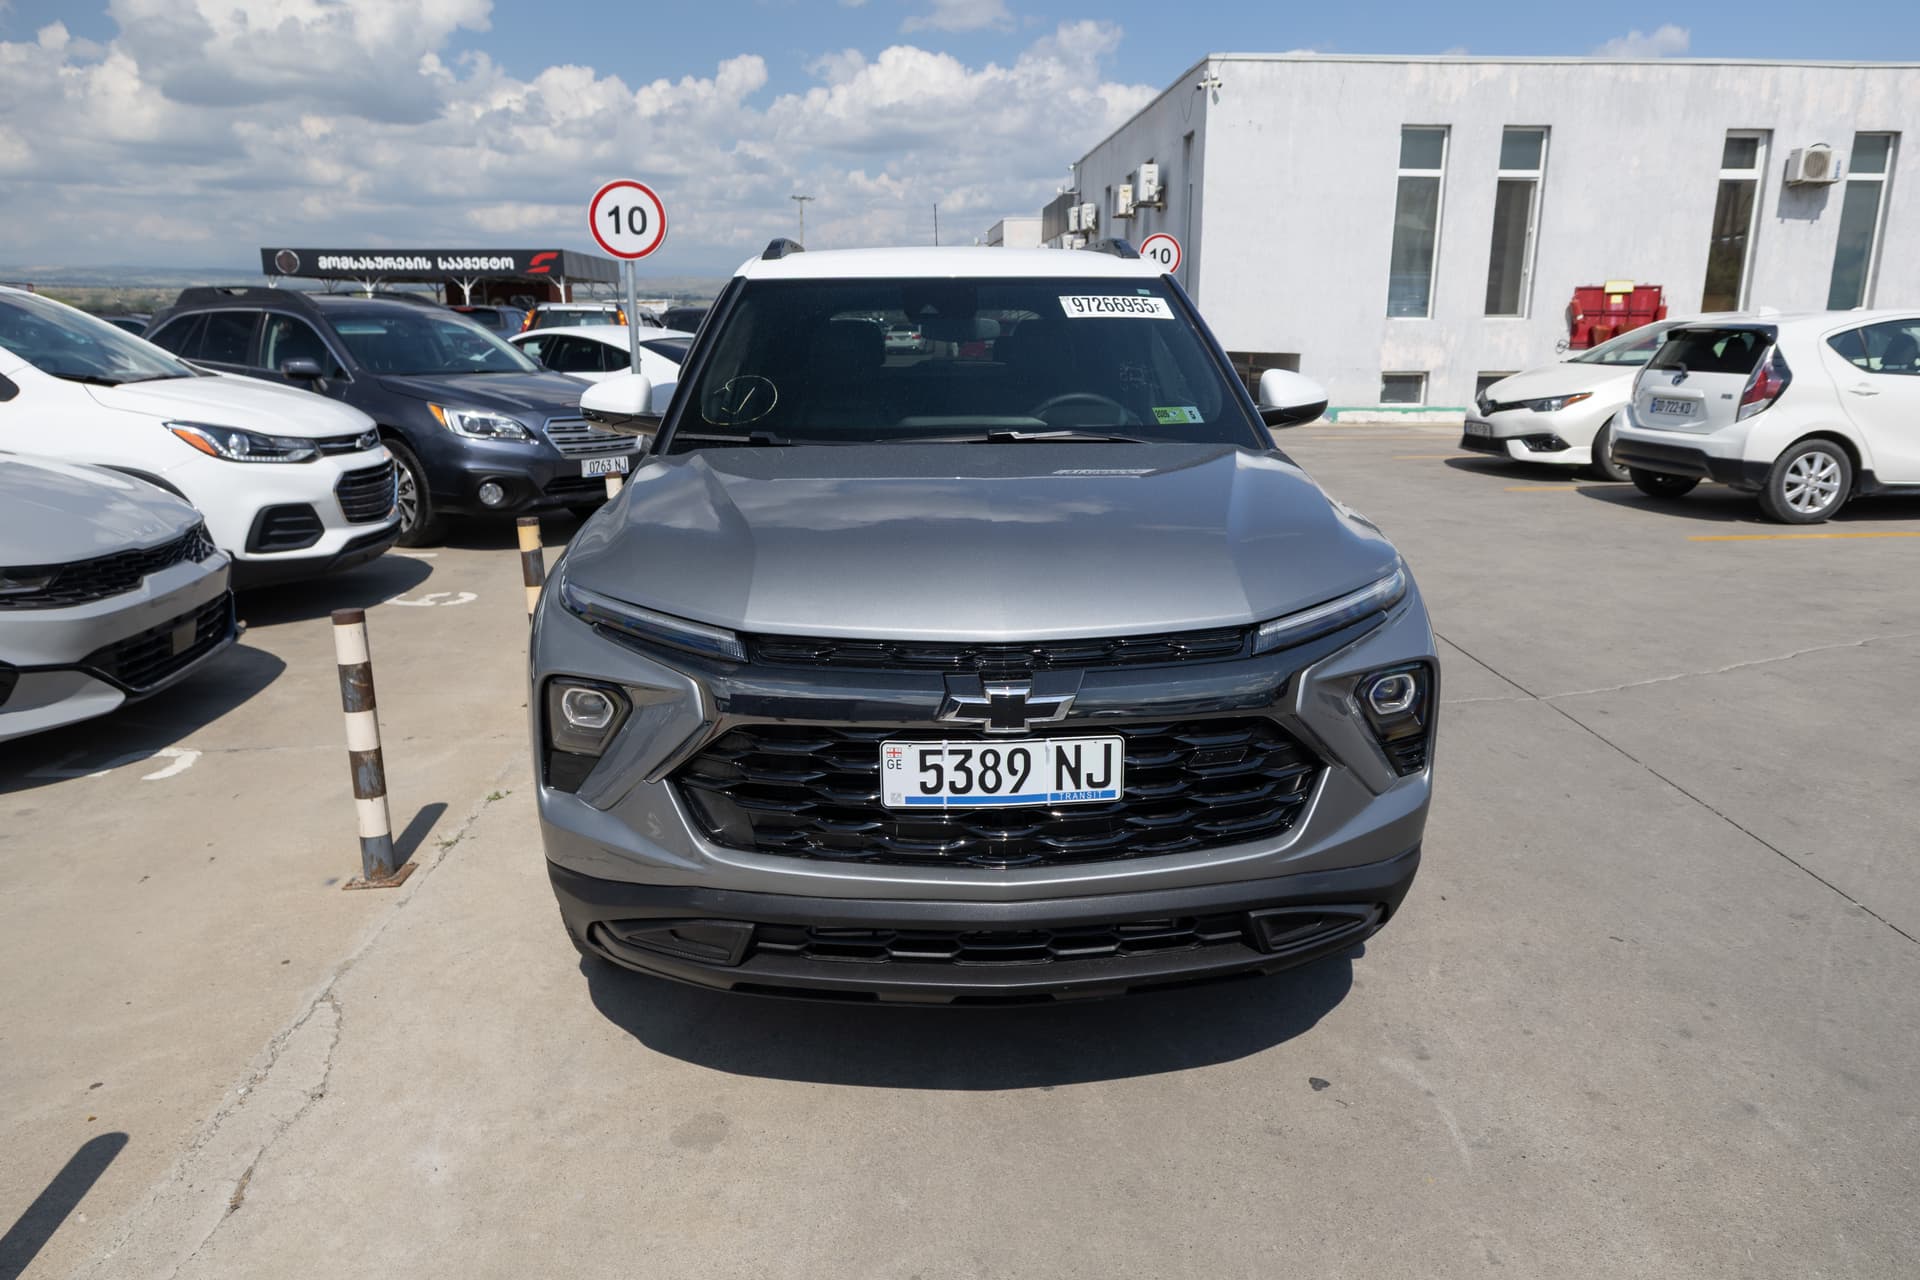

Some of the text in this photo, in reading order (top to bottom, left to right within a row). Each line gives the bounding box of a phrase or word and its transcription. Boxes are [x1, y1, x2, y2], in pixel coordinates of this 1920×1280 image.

[608, 205, 647, 235] 10
[438, 257, 515, 270] სააგენტო
[1150, 248, 1171, 264] 10
[589, 458, 627, 473] 0763 NJ
[886, 759, 902, 770] GE
[919, 743, 1112, 795] 5389 NJ
[1060, 791, 1102, 801] TRANSIT
